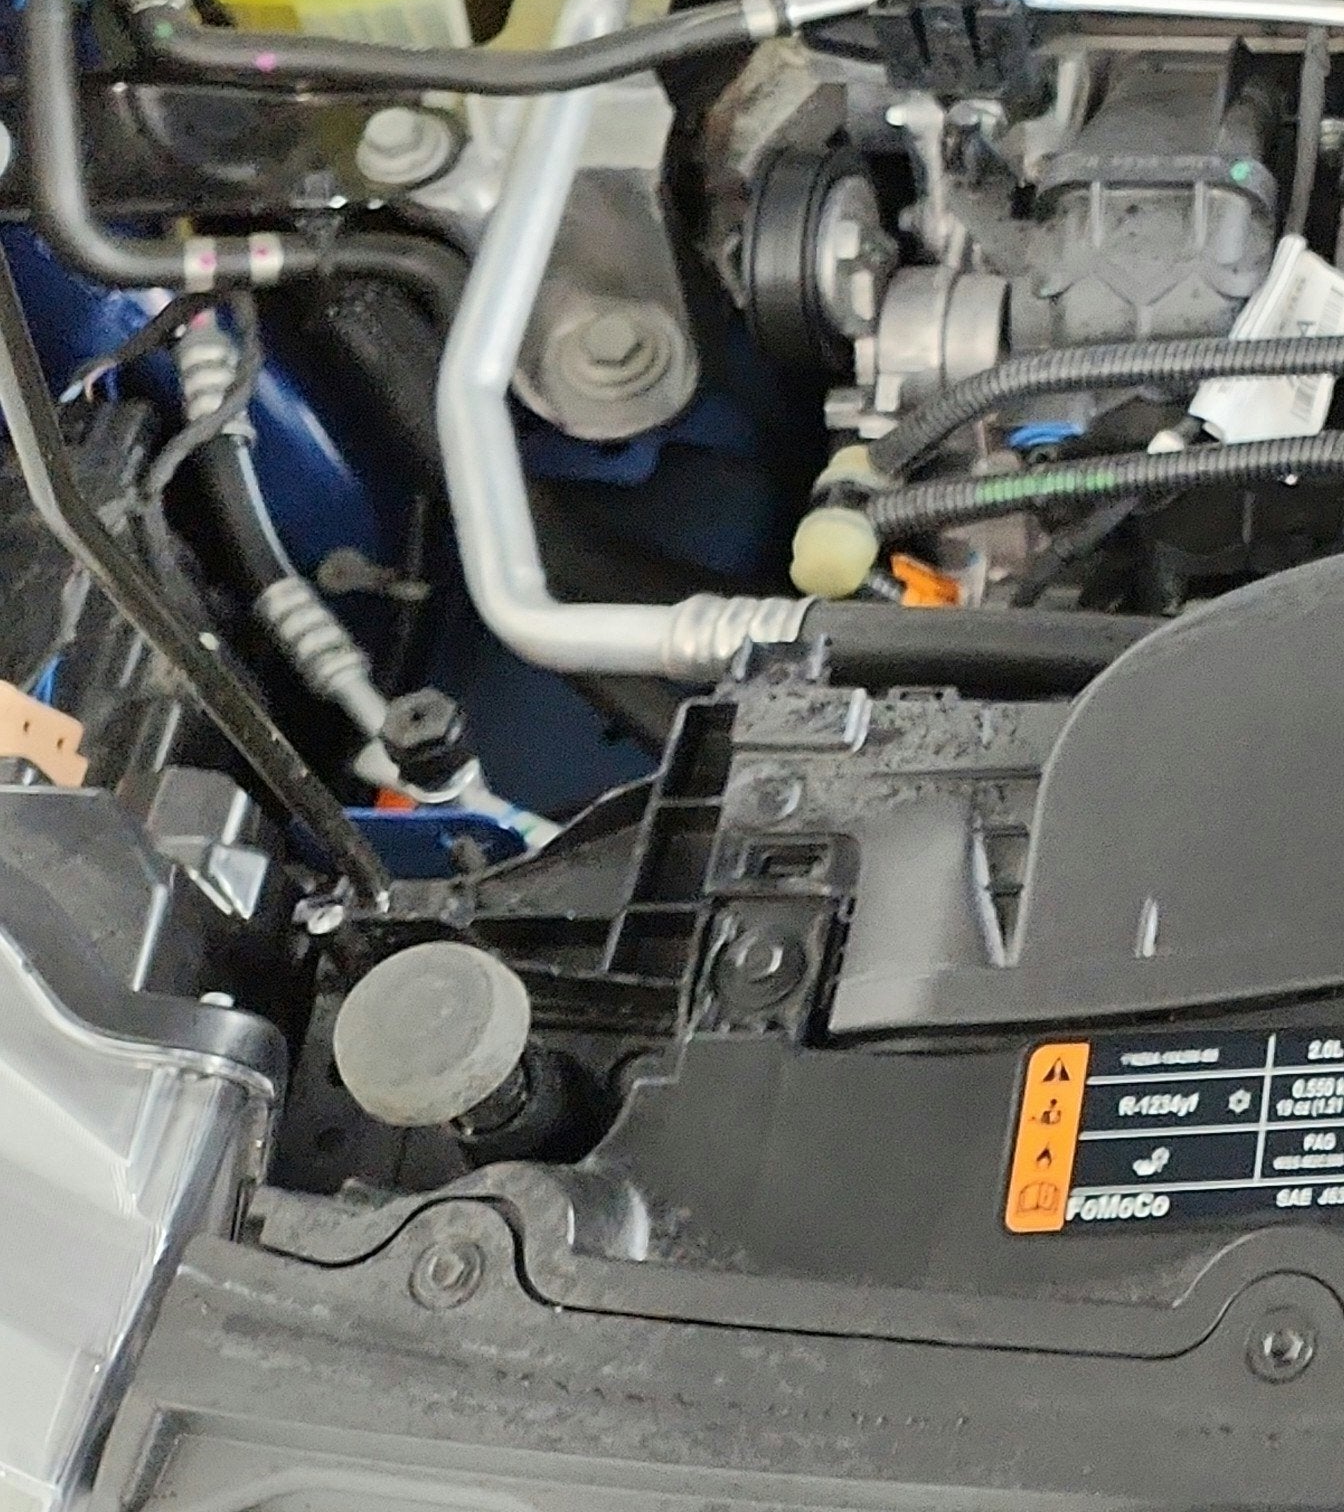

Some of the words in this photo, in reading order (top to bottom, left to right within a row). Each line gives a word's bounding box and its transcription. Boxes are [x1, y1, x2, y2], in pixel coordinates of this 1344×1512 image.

[1307, 1040, 1344, 1060] 2.0L
[1118, 1092, 1200, 1117] R-1234yf
[1065, 1192, 1170, 1221] FoMoCo
[1276, 1188, 1312, 1207] SAE
